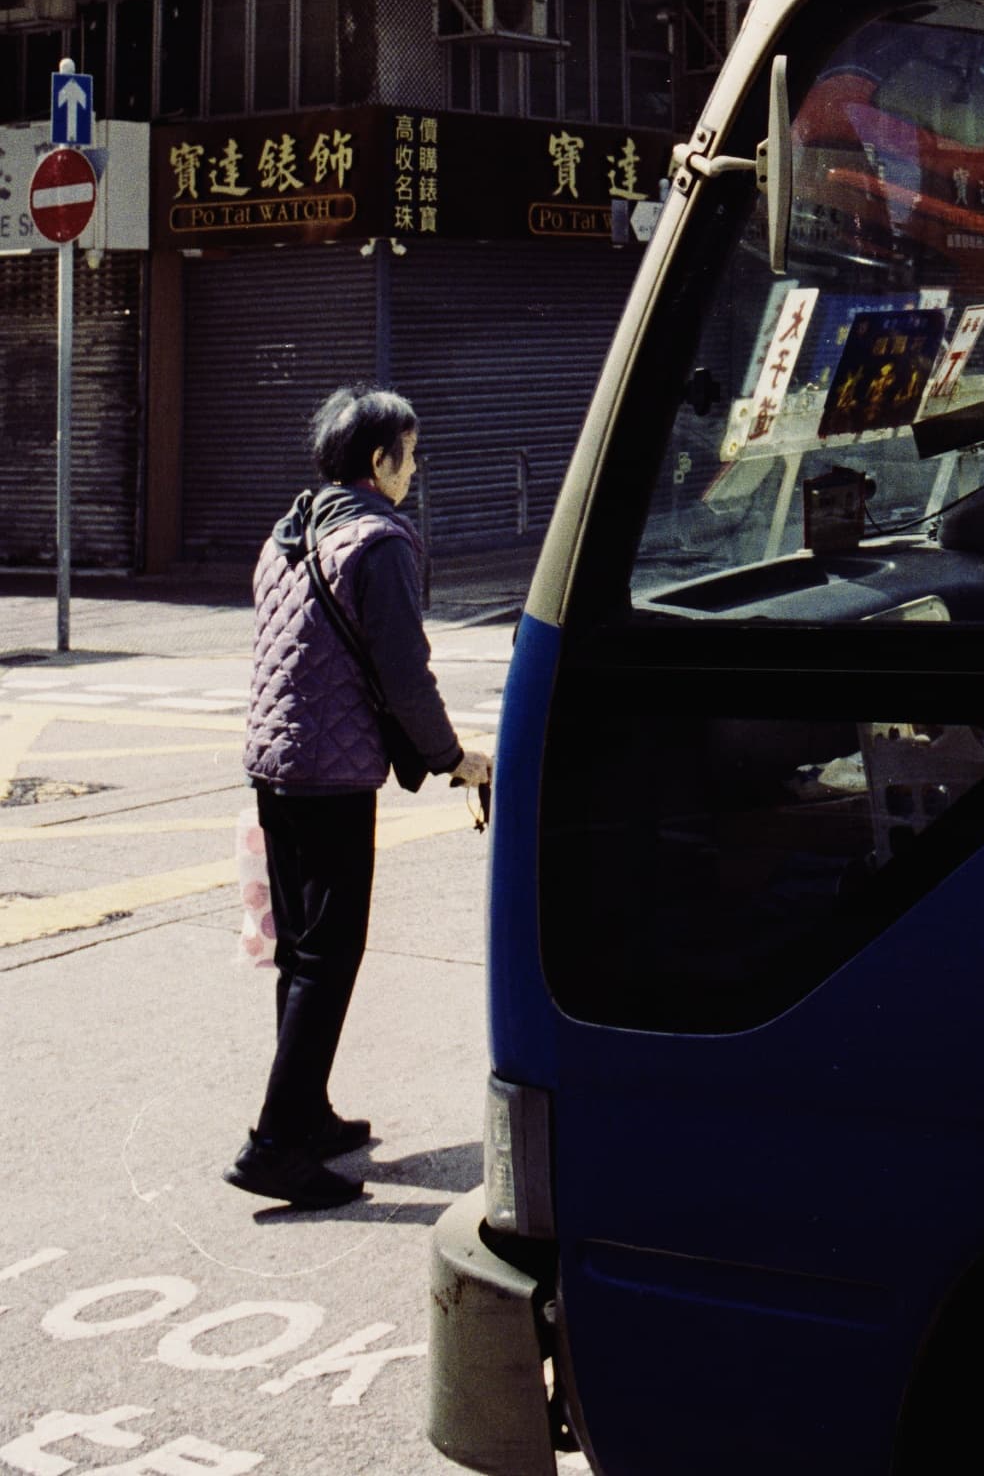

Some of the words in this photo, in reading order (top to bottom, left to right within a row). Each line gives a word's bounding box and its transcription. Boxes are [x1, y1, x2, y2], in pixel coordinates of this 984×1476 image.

[169, 128, 353, 200] 寶達錶飾
[191, 207, 215, 227] Po
[259, 200, 330, 223] WATCH
